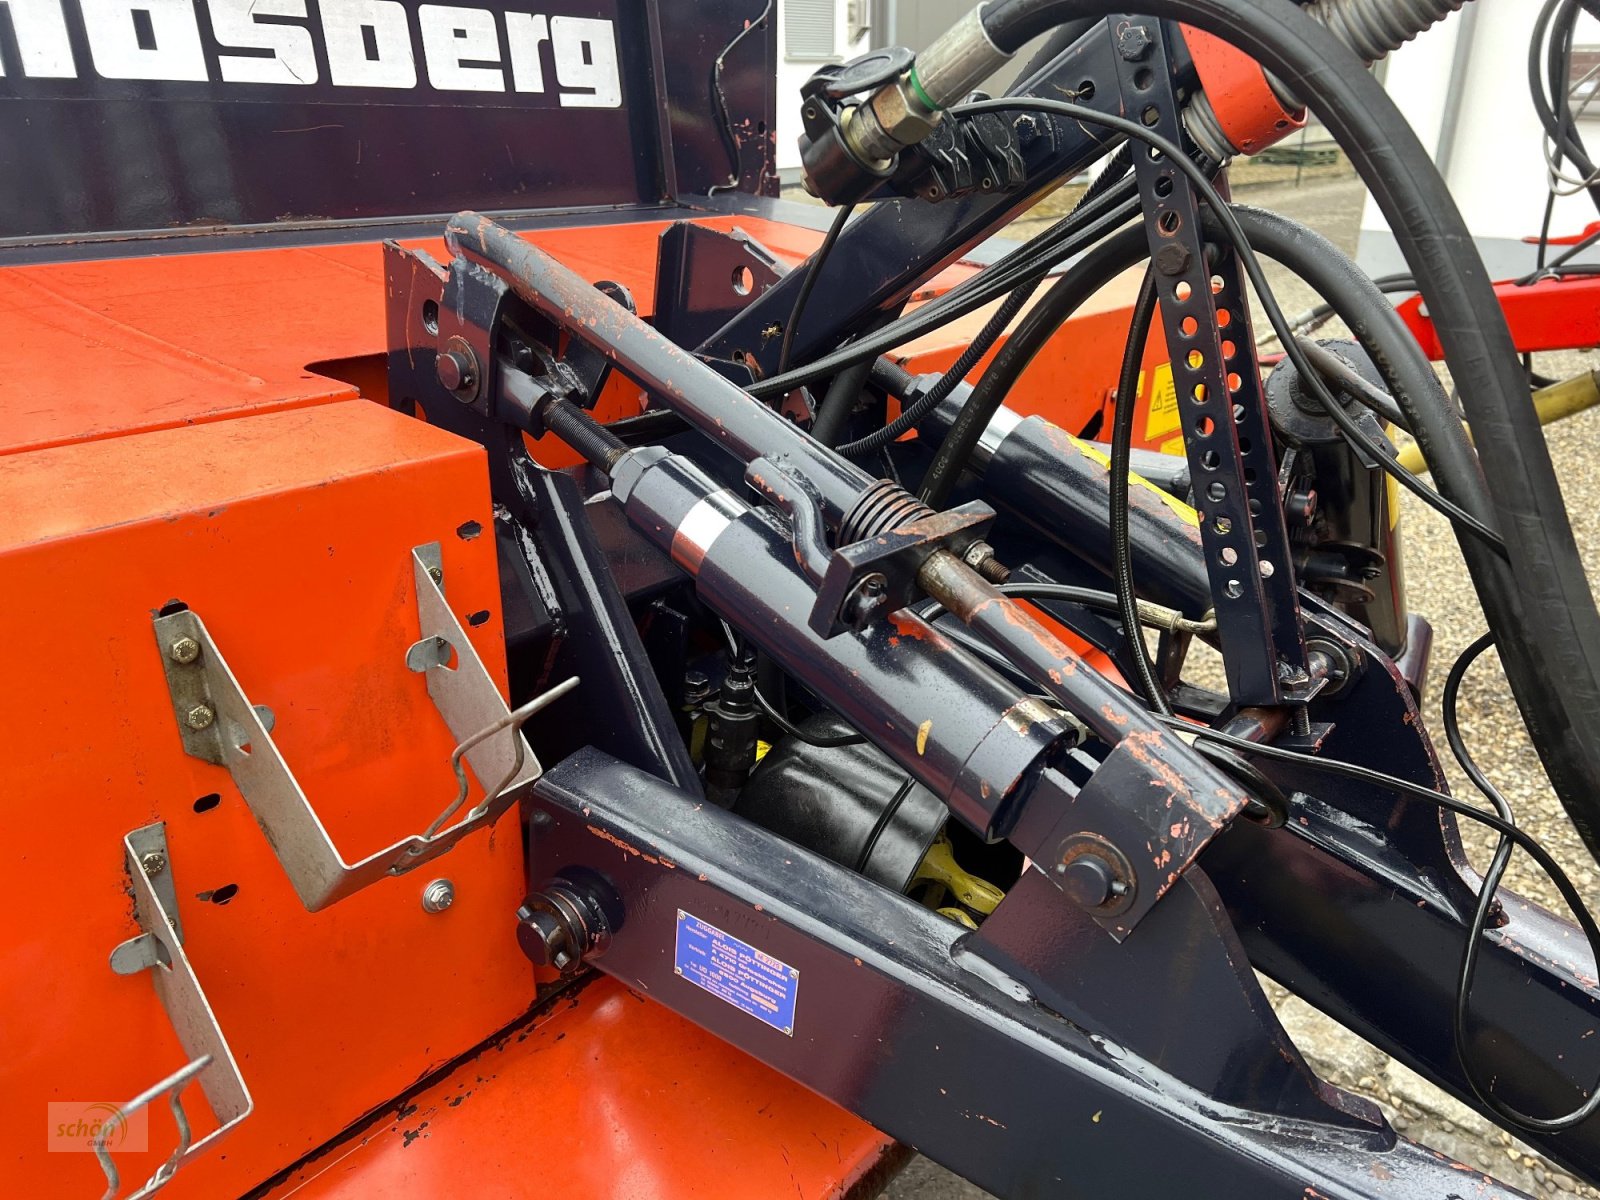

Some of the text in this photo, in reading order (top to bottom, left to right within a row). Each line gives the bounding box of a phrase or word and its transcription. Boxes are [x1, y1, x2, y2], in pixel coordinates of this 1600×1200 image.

[695, 921, 726, 941] ZUGGABEL
[712, 939, 736, 955] ALOIS
[711, 956, 735, 972] ALOIS
